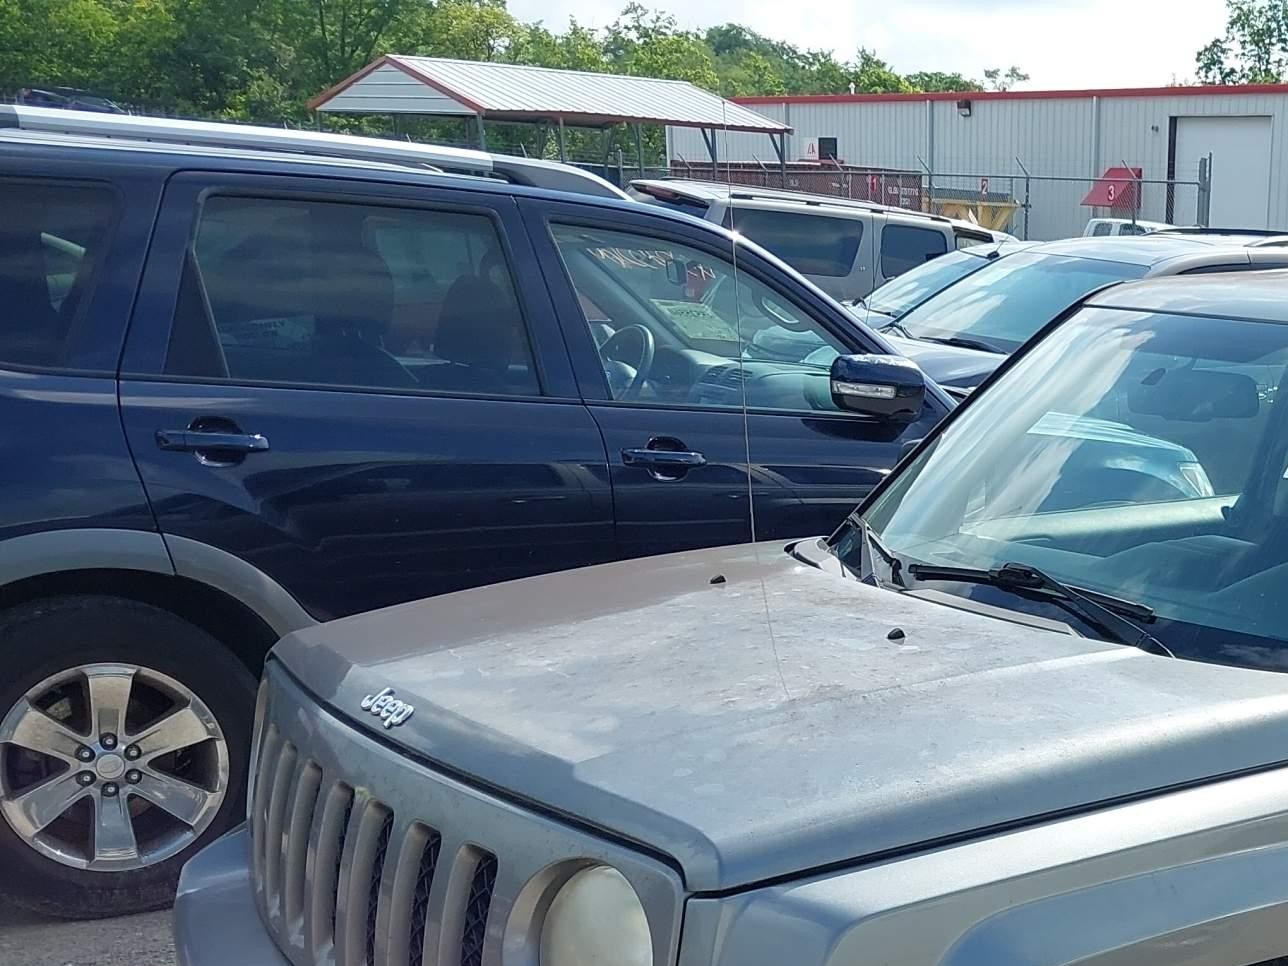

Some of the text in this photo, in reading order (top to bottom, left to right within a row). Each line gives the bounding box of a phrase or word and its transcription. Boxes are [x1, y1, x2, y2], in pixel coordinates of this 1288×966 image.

[981, 180, 988, 195] 2
[1108, 185, 1115, 201] 3
[361, 687, 415, 729] Jeep
